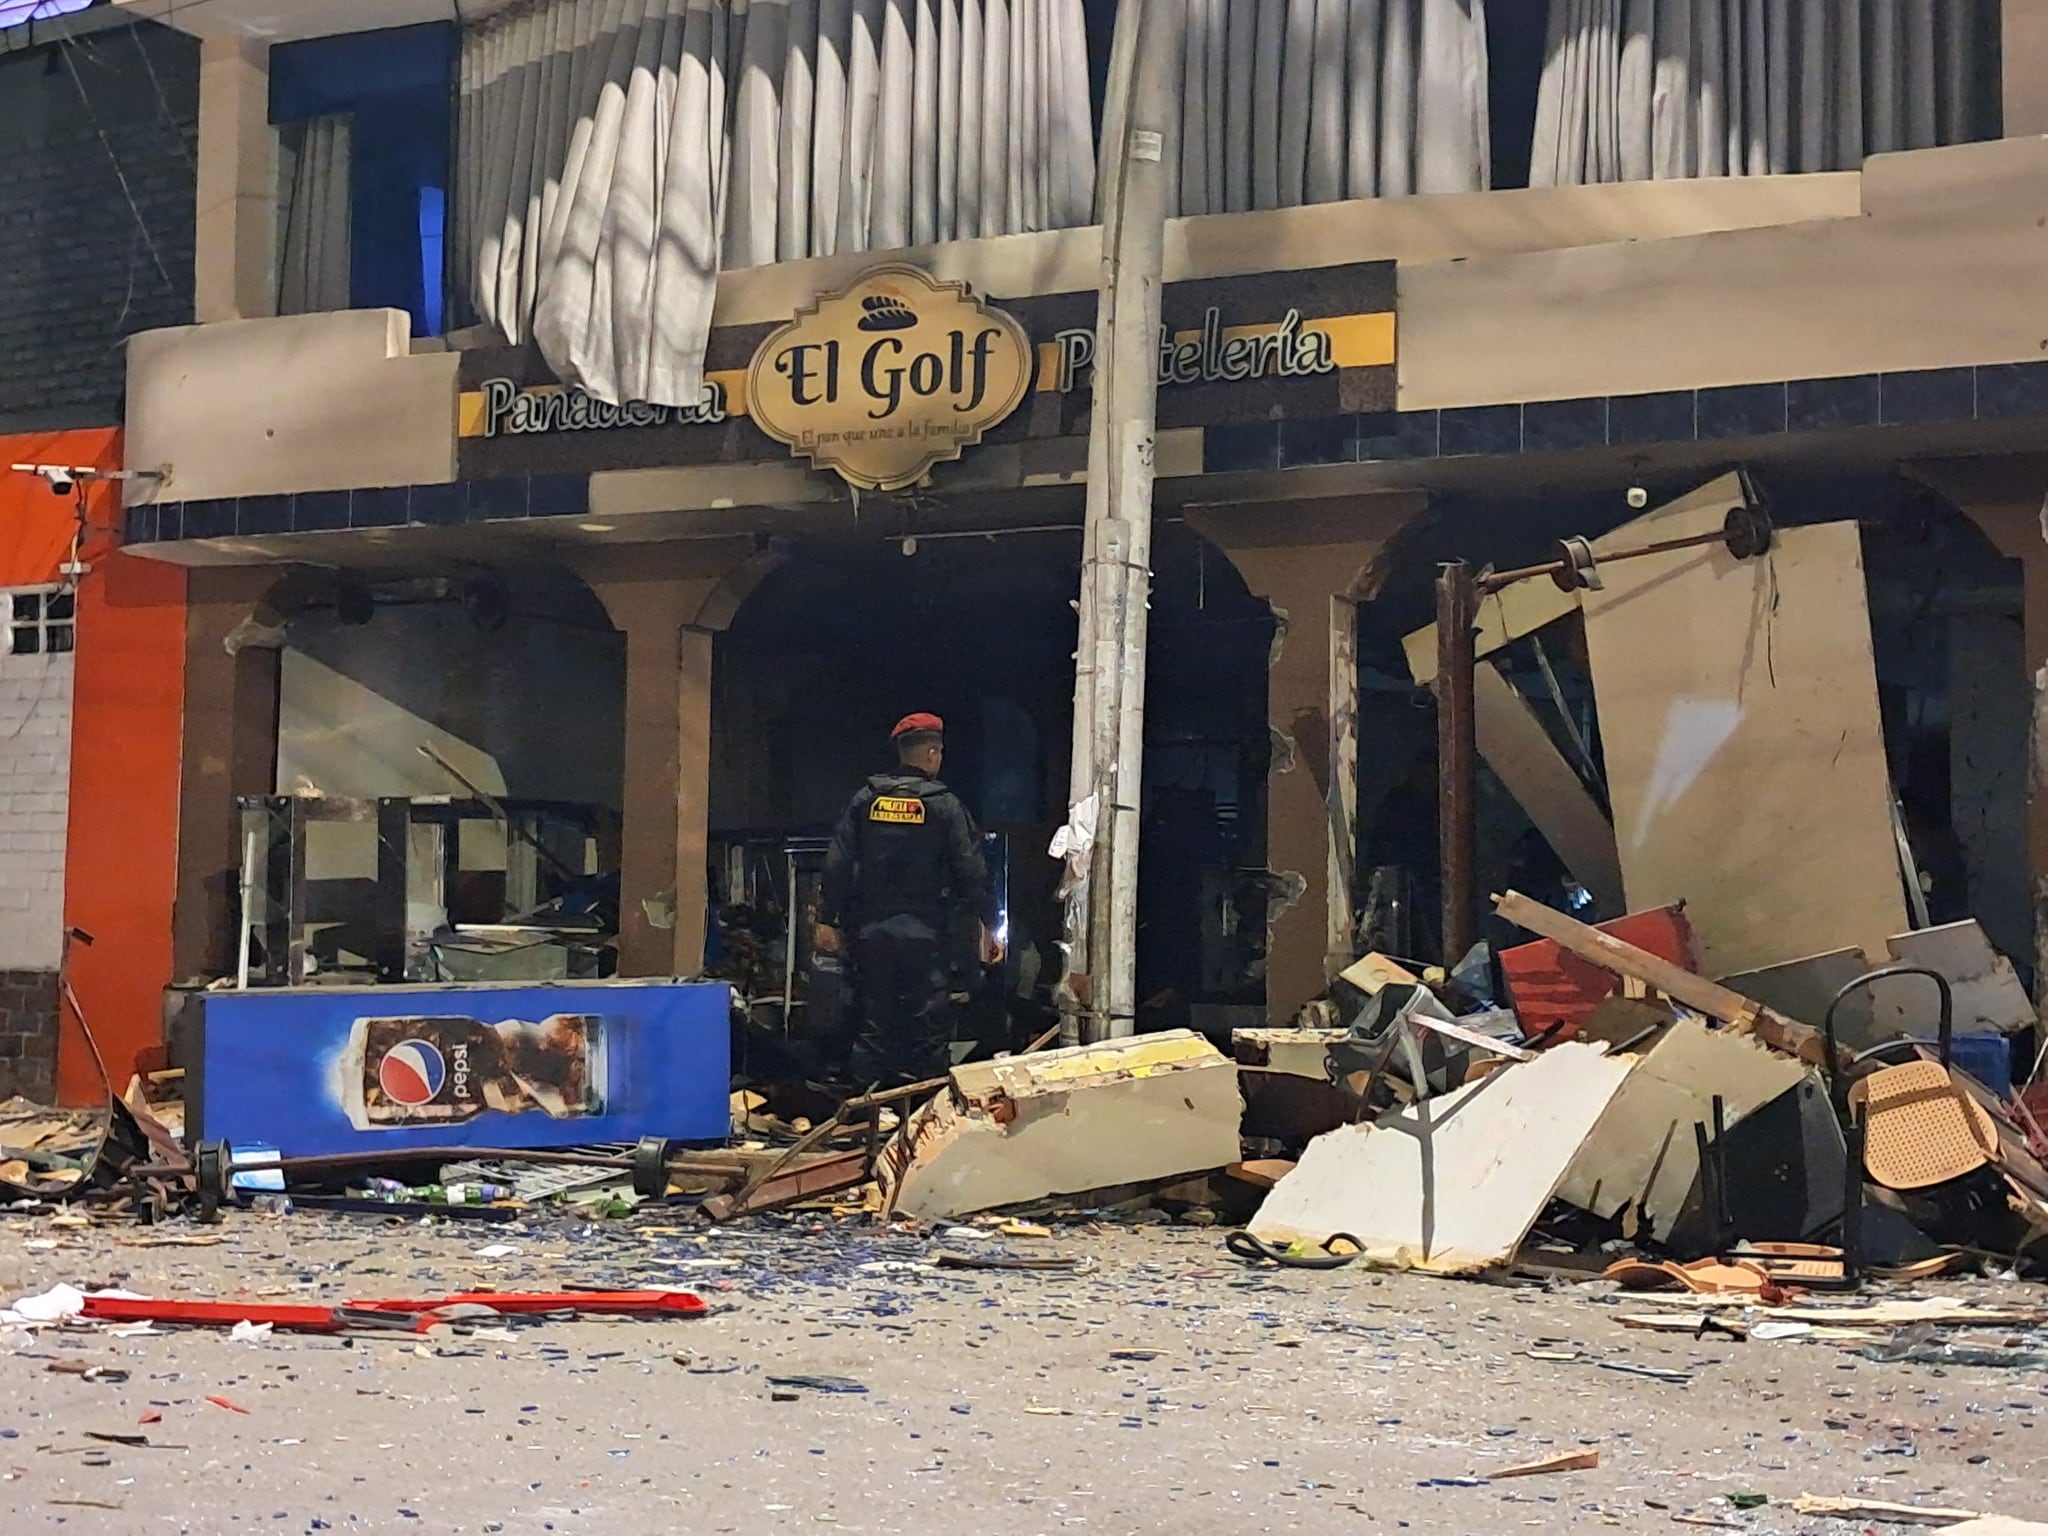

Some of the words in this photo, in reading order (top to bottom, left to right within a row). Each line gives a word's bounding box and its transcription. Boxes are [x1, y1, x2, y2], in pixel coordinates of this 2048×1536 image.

[775, 340, 839, 405] El
[861, 328, 1001, 419] Golf
[1055, 307, 1333, 393] Ptelería
[452, 1043, 471, 1098] pepsi
